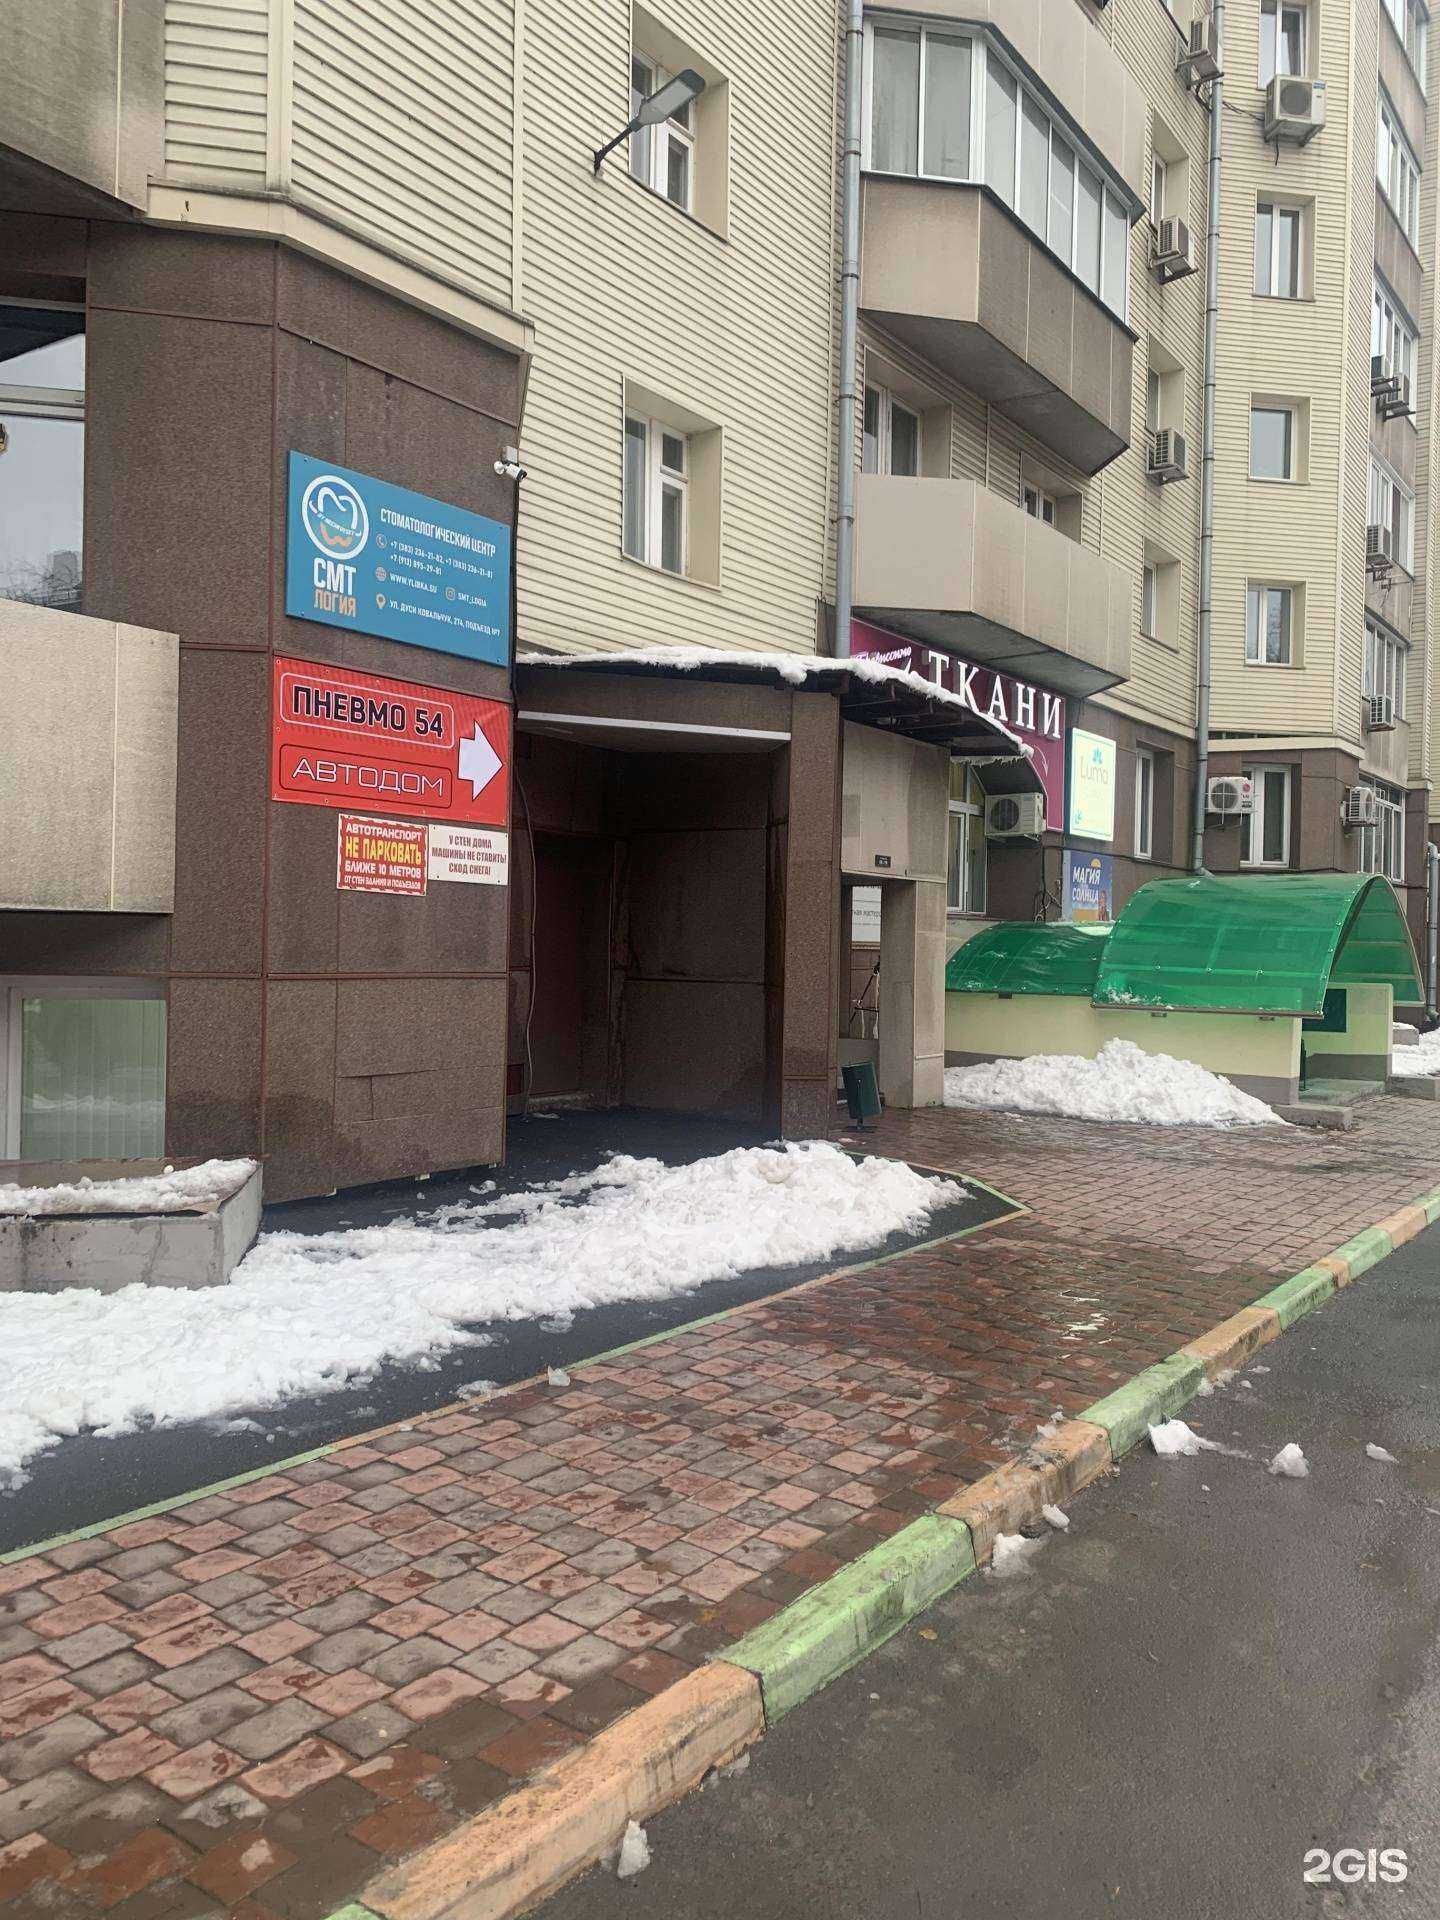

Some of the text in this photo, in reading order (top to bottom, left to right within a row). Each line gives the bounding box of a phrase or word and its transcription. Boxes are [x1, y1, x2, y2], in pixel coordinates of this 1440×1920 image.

[380, 508, 470, 549] СТОМАТОЛОГИЧЕСКИЙ
[471, 538, 496, 557] ЦЕНТР
[314, 588, 356, 618] ЛОГИЯ
[928, 650, 1062, 738] ТКАНИ
[292, 684, 444, 739] ПНЕВМО 54
[292, 757, 443, 796] АВТОДОМ
[346, 822, 422, 842] АВТОТРАНСПОРТ
[345, 836, 422, 865] НЕ ПАРКОВАТЬ
[454, 836, 472, 847] СТЕН
[472, 838, 492, 850] ДОМА
[432, 846, 507, 864] МАШИНЫ НЕ СТАВИТЬ!
[344, 860, 422, 879] БЛИЖЕ 10 МЕТРОВ
[448, 864, 468, 875] СХОД
[1072, 866, 1100, 885] МАГИЯ
[1072, 888, 1098, 904] СОЛНЦА
